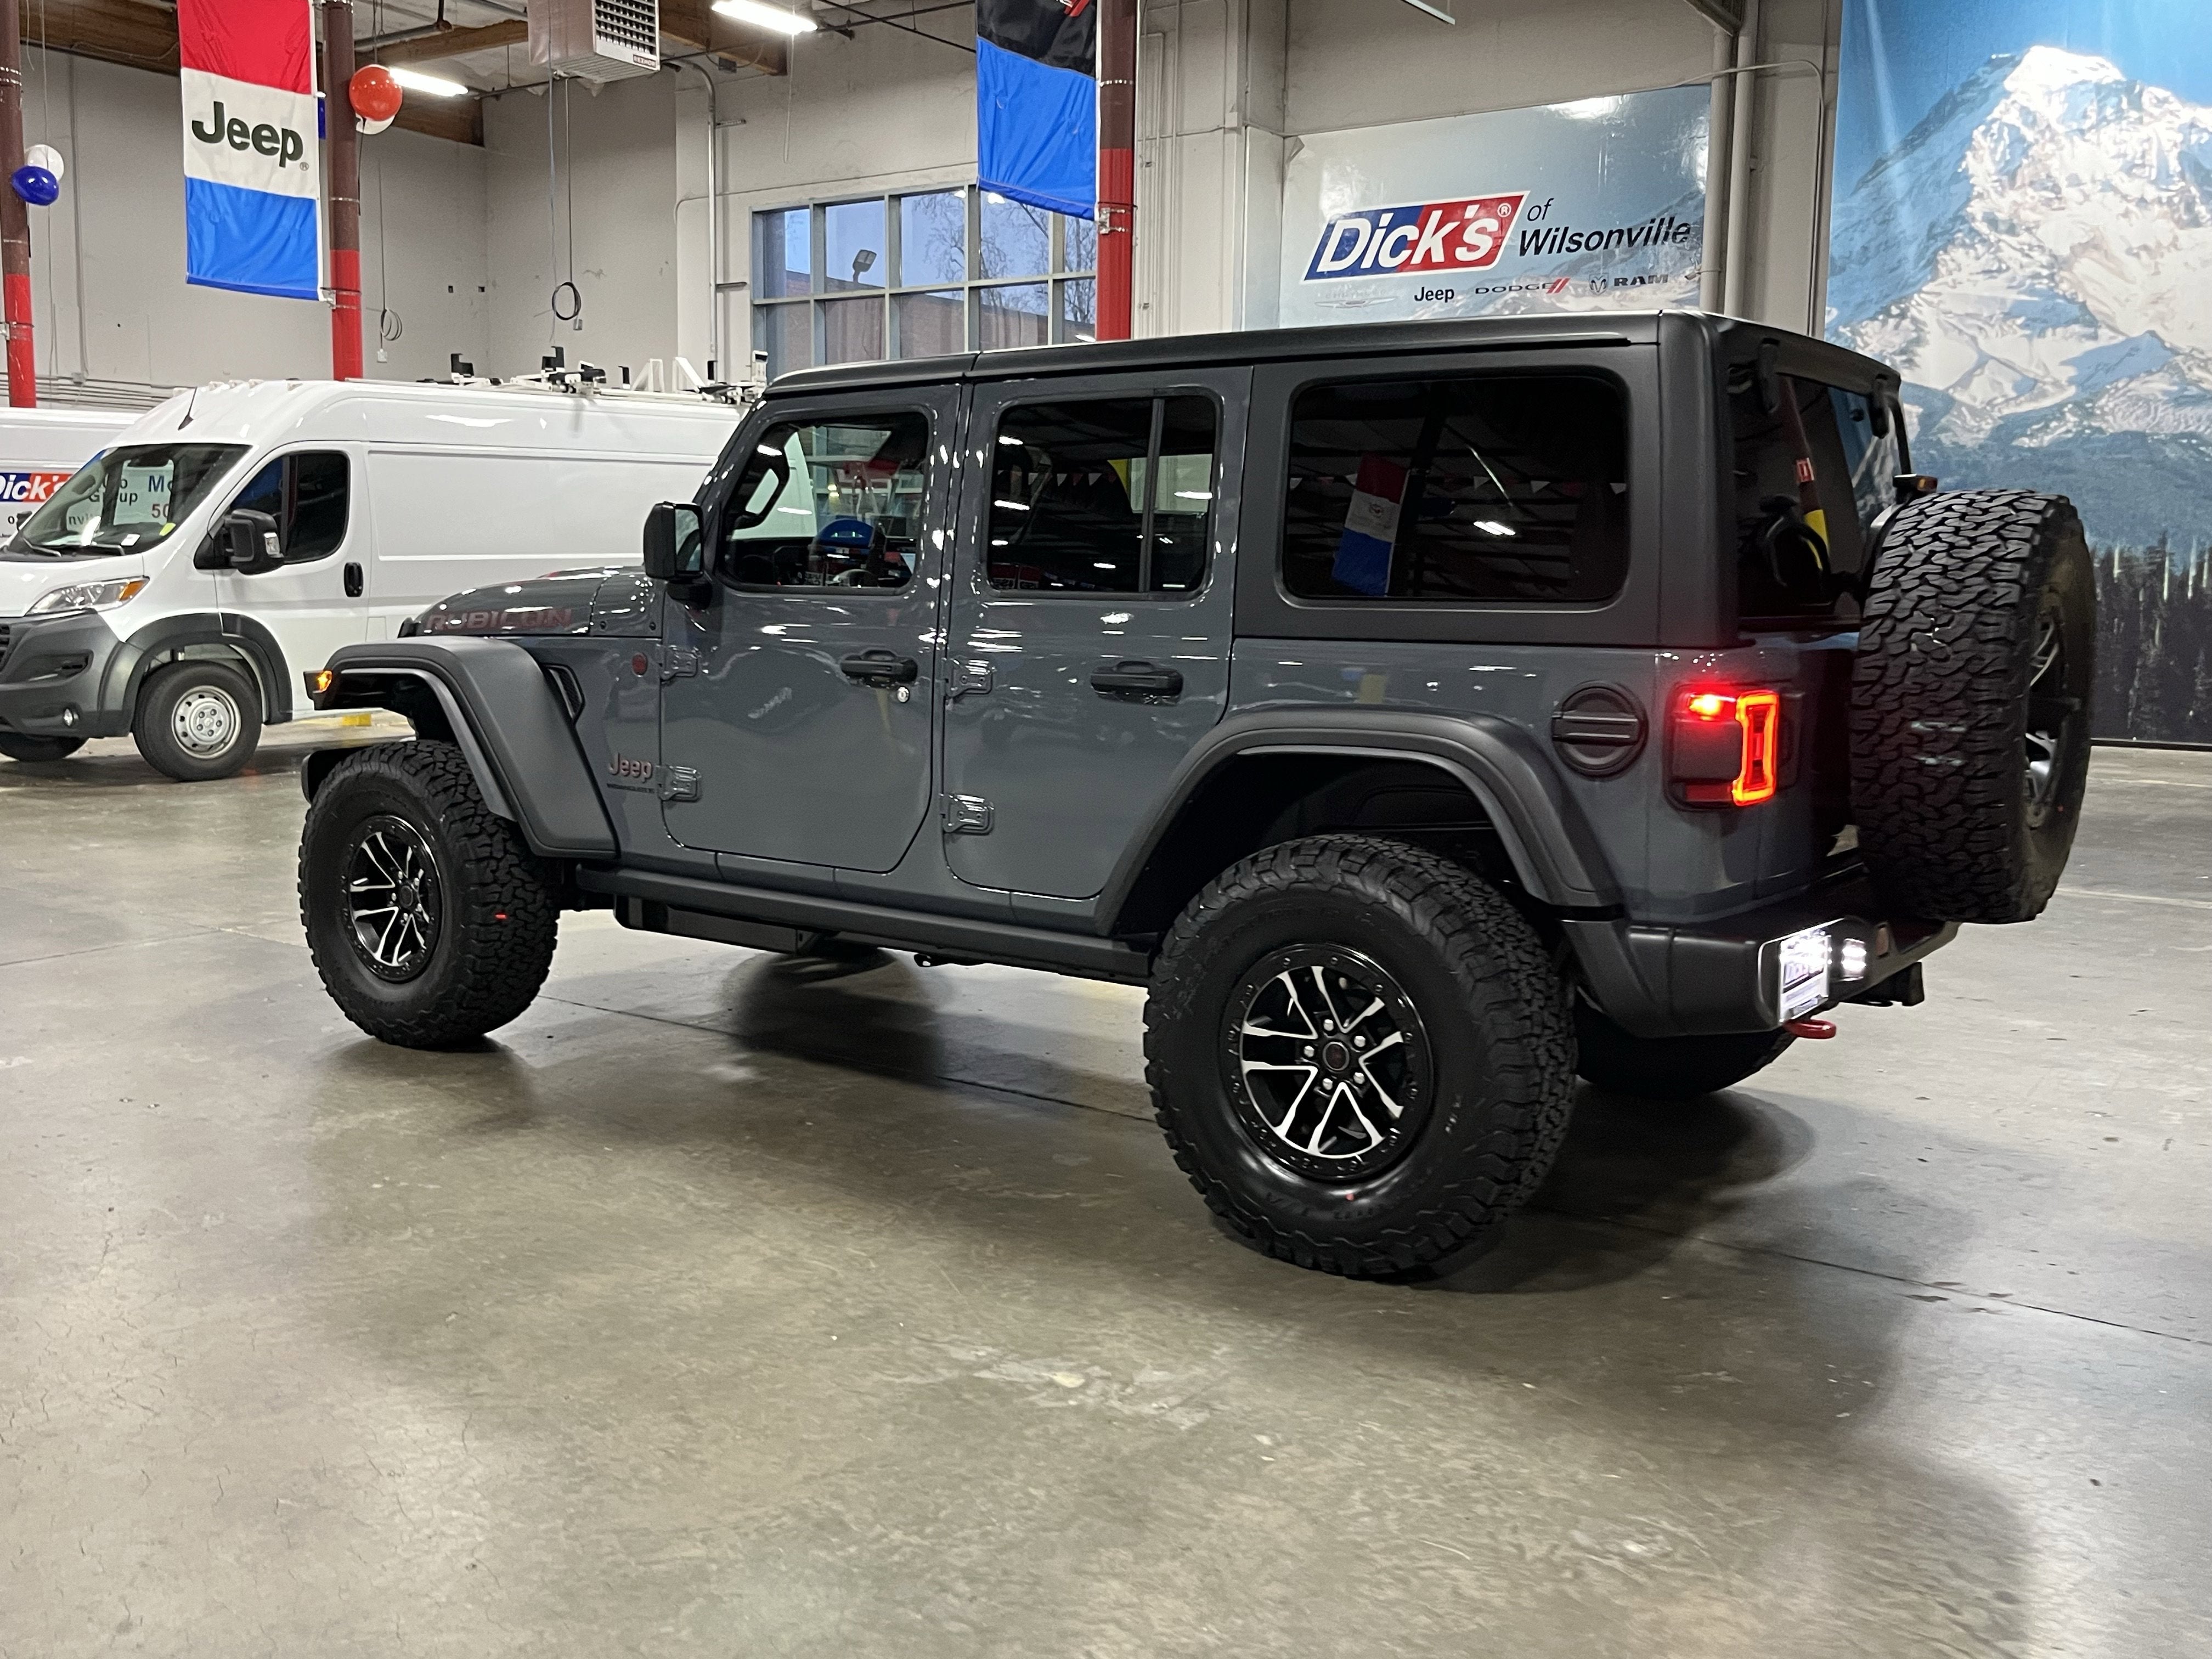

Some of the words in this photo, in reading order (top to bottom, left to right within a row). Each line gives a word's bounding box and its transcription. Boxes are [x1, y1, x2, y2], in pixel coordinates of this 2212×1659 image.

[192, 100, 303, 168] Jeep
[1527, 198, 1554, 222] of
[1316, 204, 1499, 273] Dick's
[1519, 217, 1691, 257] Wilsonville
[1414, 281, 1455, 303] Jeep
[1475, 282, 1556, 295] DODGE
[1614, 274, 1668, 287] RAM
[425, 608, 572, 631] RUBICON
[607, 752, 653, 784] Jeep
